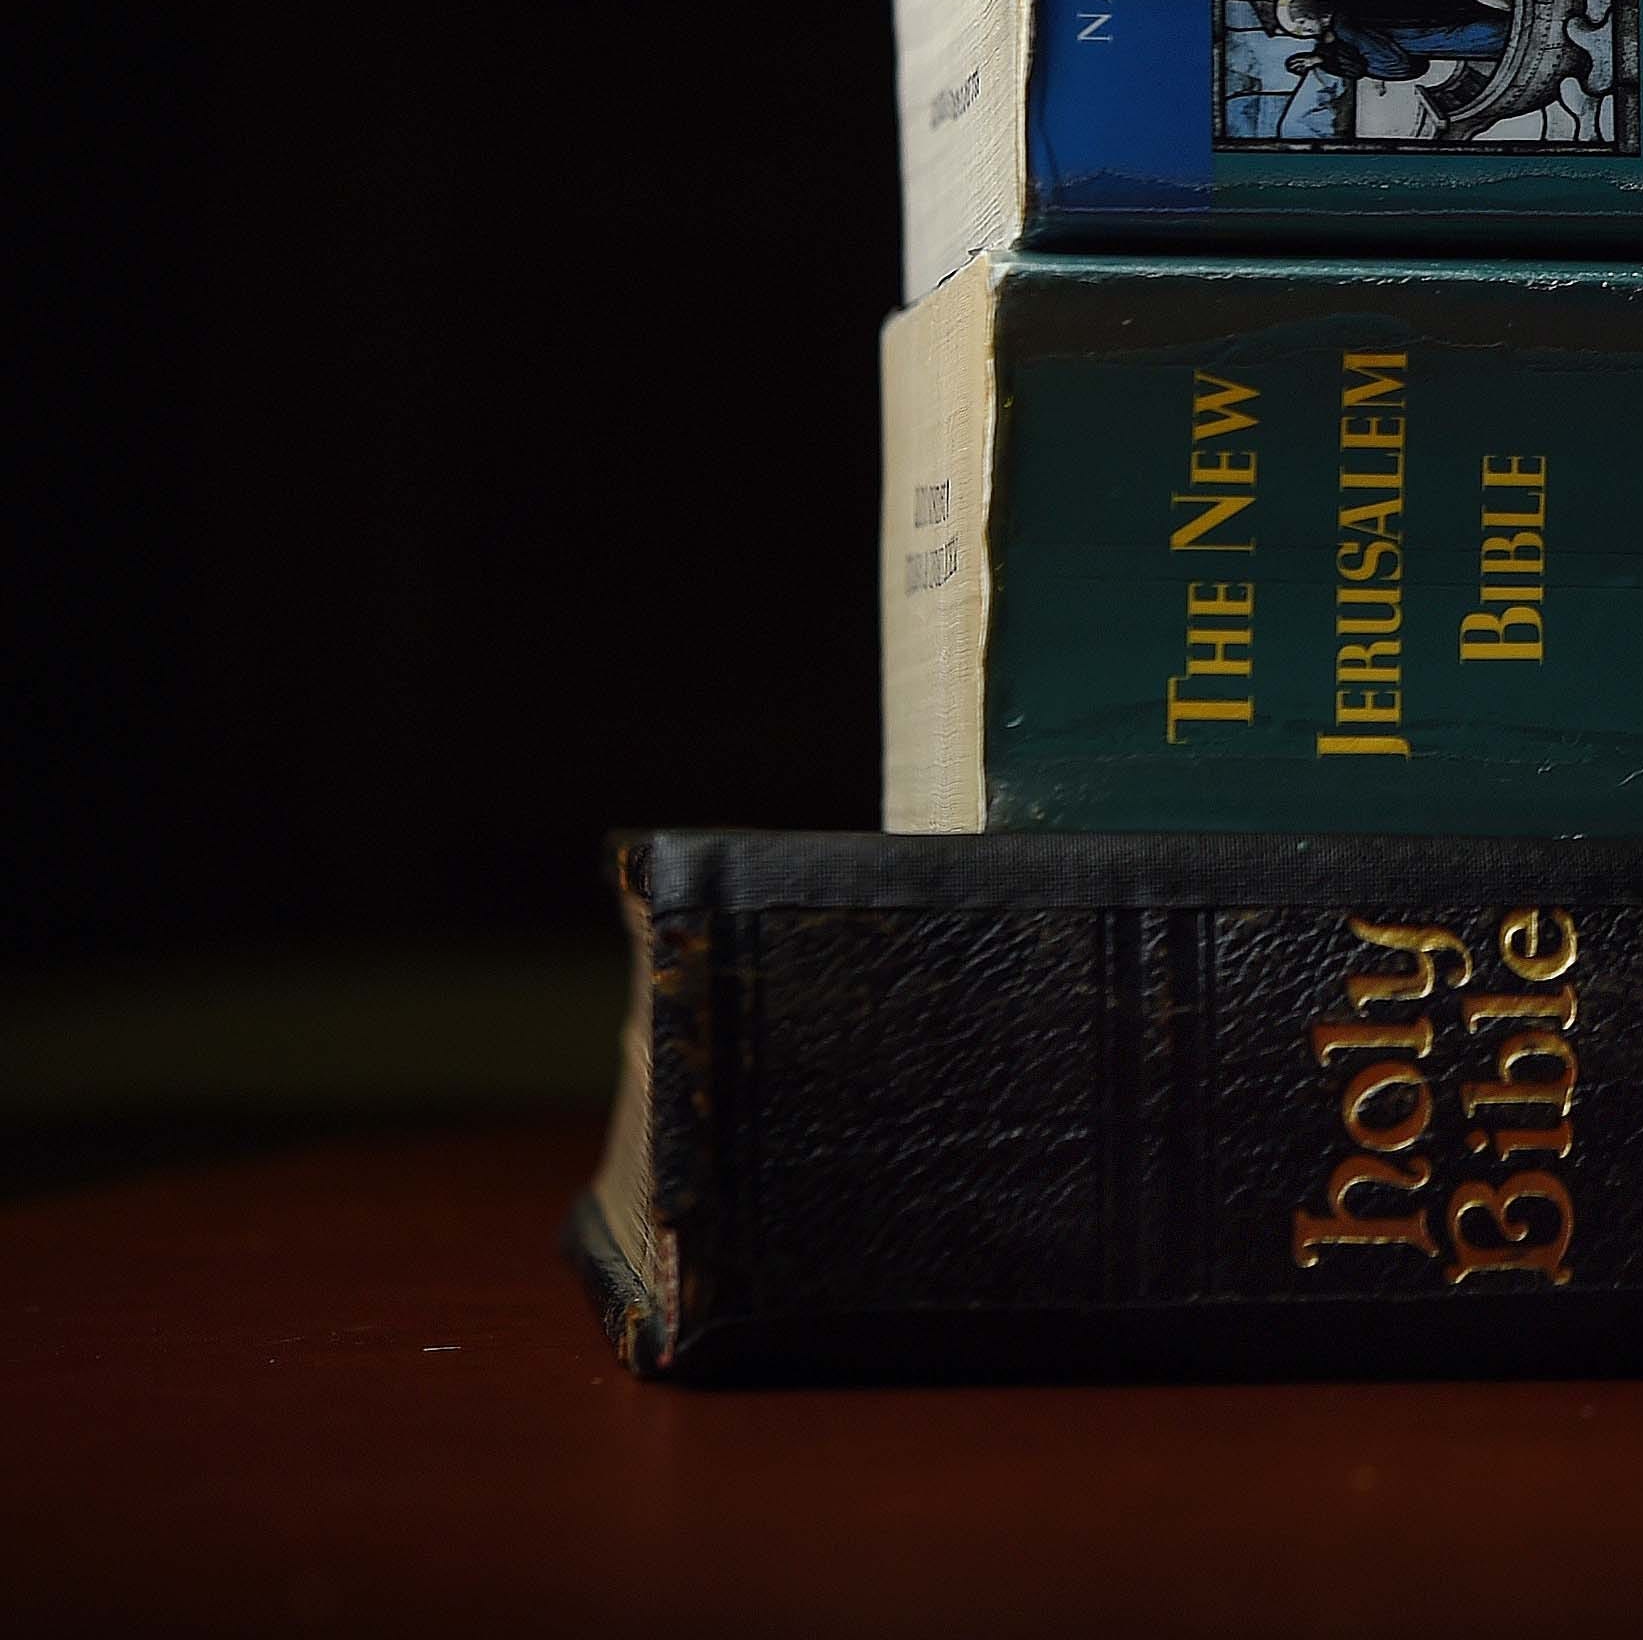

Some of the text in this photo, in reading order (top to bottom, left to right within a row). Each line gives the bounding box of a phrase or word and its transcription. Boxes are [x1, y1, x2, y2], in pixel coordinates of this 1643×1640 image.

[1166, 369, 1261, 745] THE NEW
[1317, 351, 1412, 760] JERUSALEM
[1459, 455, 1548, 665] BIBLE
[1440, 904, 1579, 1286] Bible
